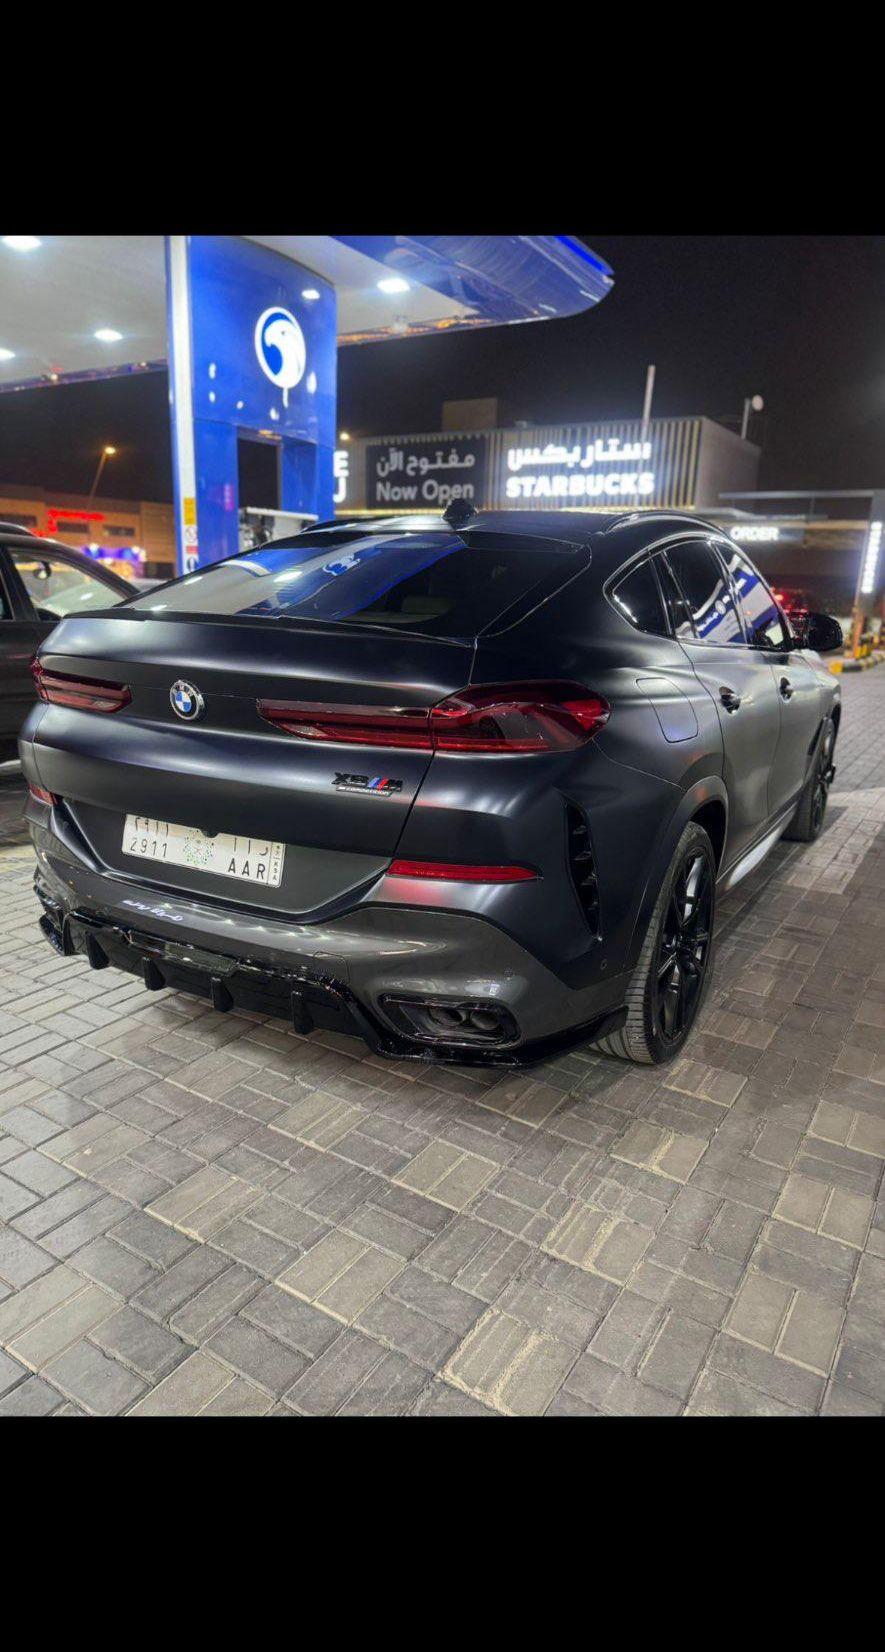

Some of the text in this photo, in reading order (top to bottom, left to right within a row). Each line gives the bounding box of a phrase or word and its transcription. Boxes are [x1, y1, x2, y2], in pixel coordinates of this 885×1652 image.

[405, 449, 476, 476] مفتوح
[507, 438, 652, 471] ستاربكس
[376, 479, 474, 505] Now Open
[505, 472, 655, 498] STARBUCKS
[730, 526, 779, 541] ORDER
[130, 838, 168, 859] 2911
[228, 857, 266, 880] AAR
